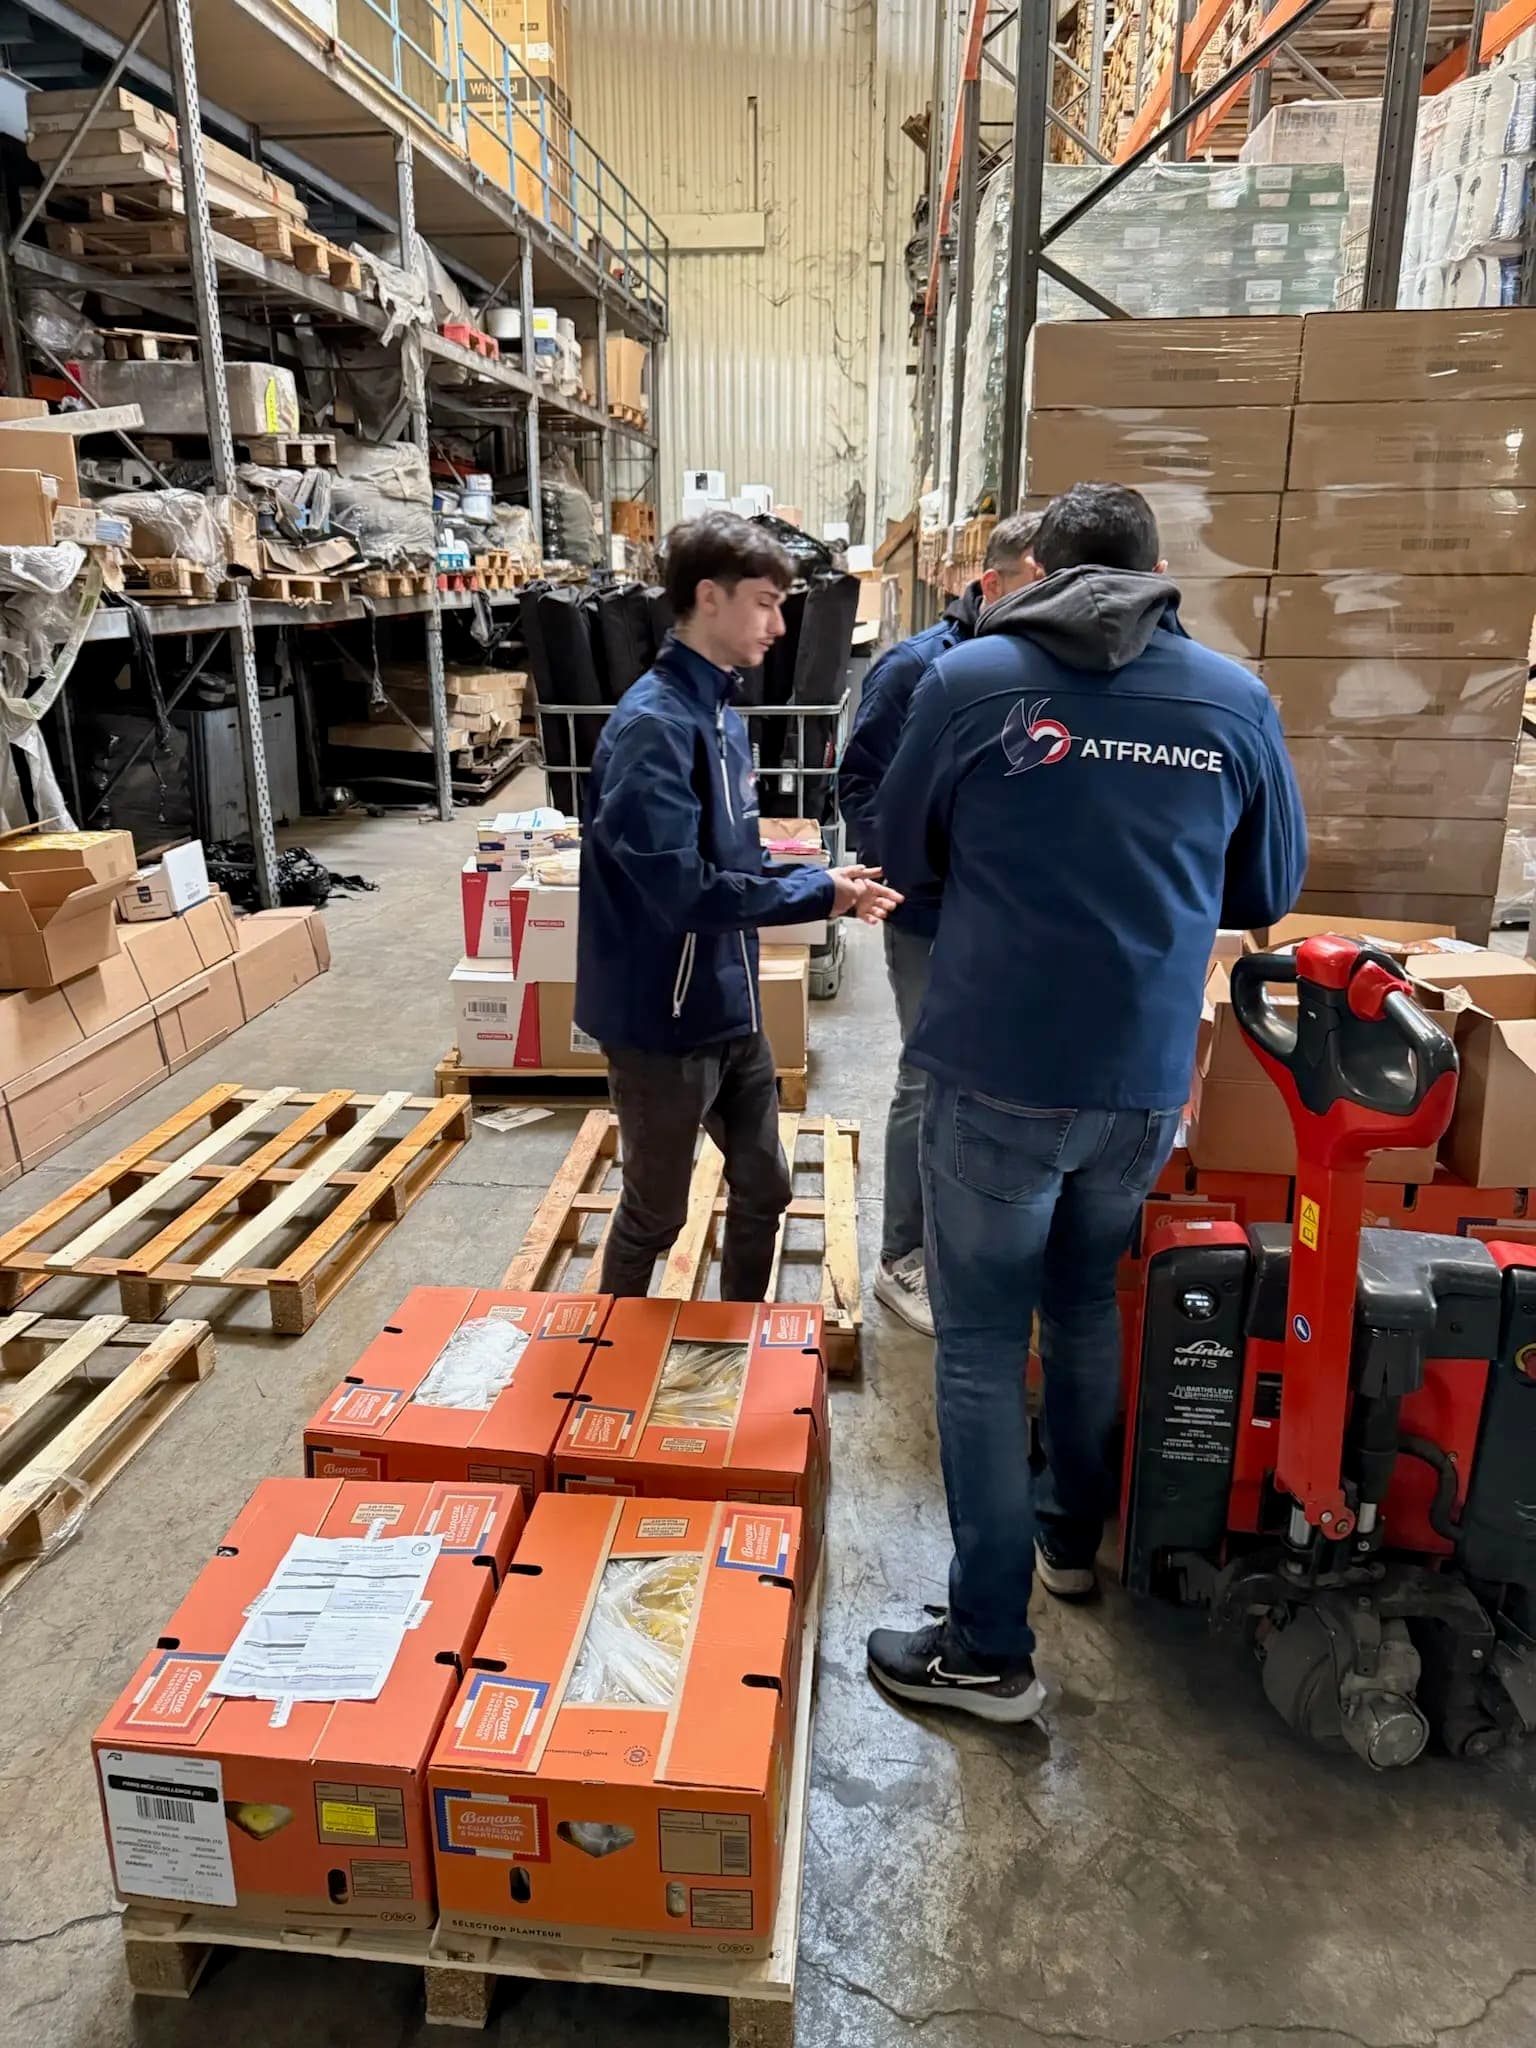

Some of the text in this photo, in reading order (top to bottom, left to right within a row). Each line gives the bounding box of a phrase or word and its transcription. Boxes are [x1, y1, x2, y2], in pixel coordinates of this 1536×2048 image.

[1080, 738, 1224, 774] ATFRANCE
[1174, 1339, 1234, 1358] Linde
[741, 1521, 757, 1558] Banane
[493, 1695, 519, 1744] Banane
[460, 1811, 527, 1828] Banane
[467, 1825, 524, 1837] GUADELOUPE
[467, 1831, 521, 1842] MARTINIQUE
[509, 1926, 562, 1939] PLANTEUR
